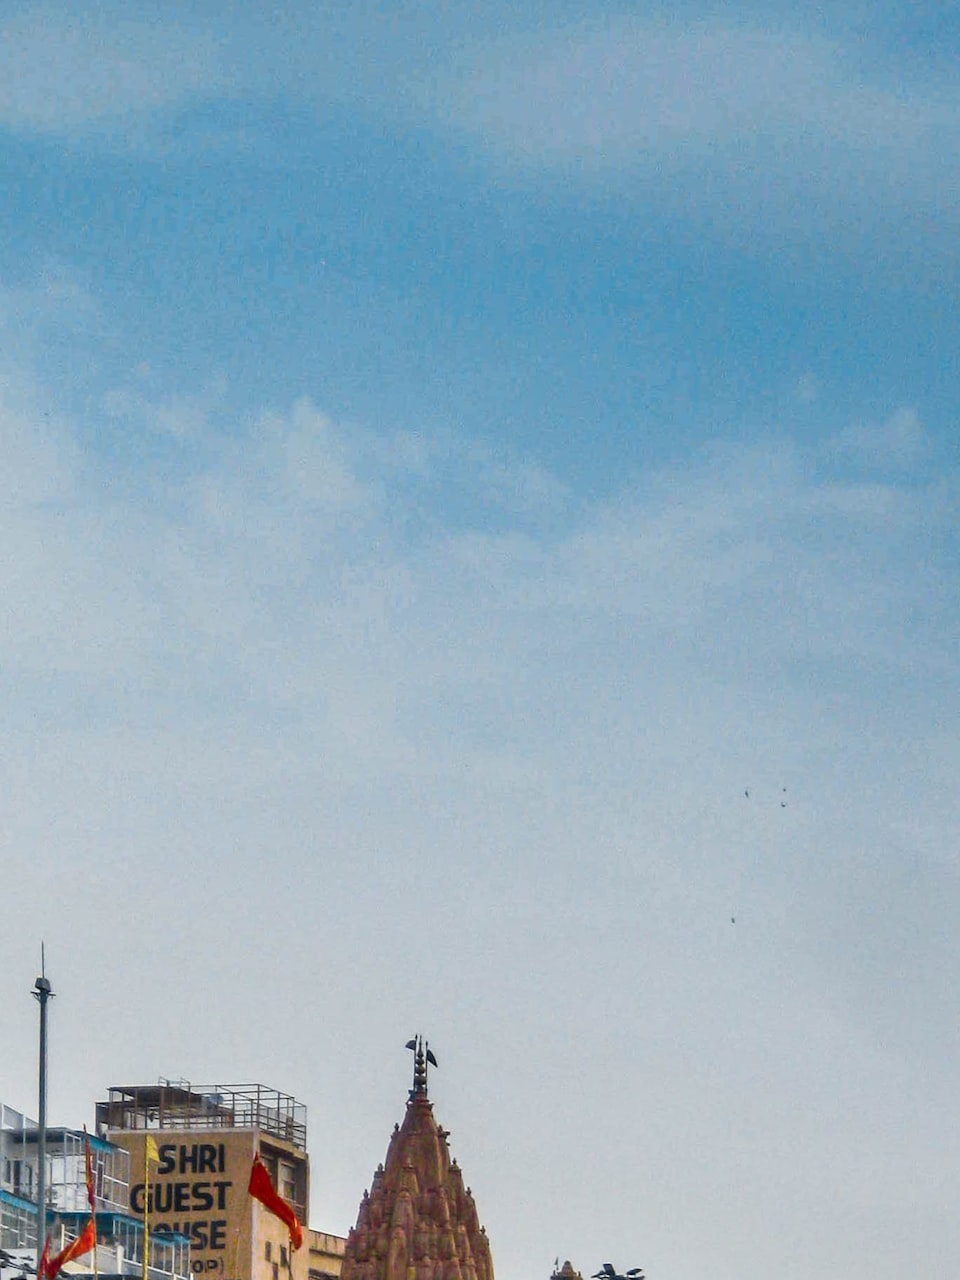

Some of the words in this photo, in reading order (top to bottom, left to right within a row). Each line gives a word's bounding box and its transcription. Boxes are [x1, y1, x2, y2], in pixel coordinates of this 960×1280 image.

[157, 1143, 226, 1174] SHRI
[129, 1181, 232, 1214] GUEST
[148, 1220, 227, 1250] USE
